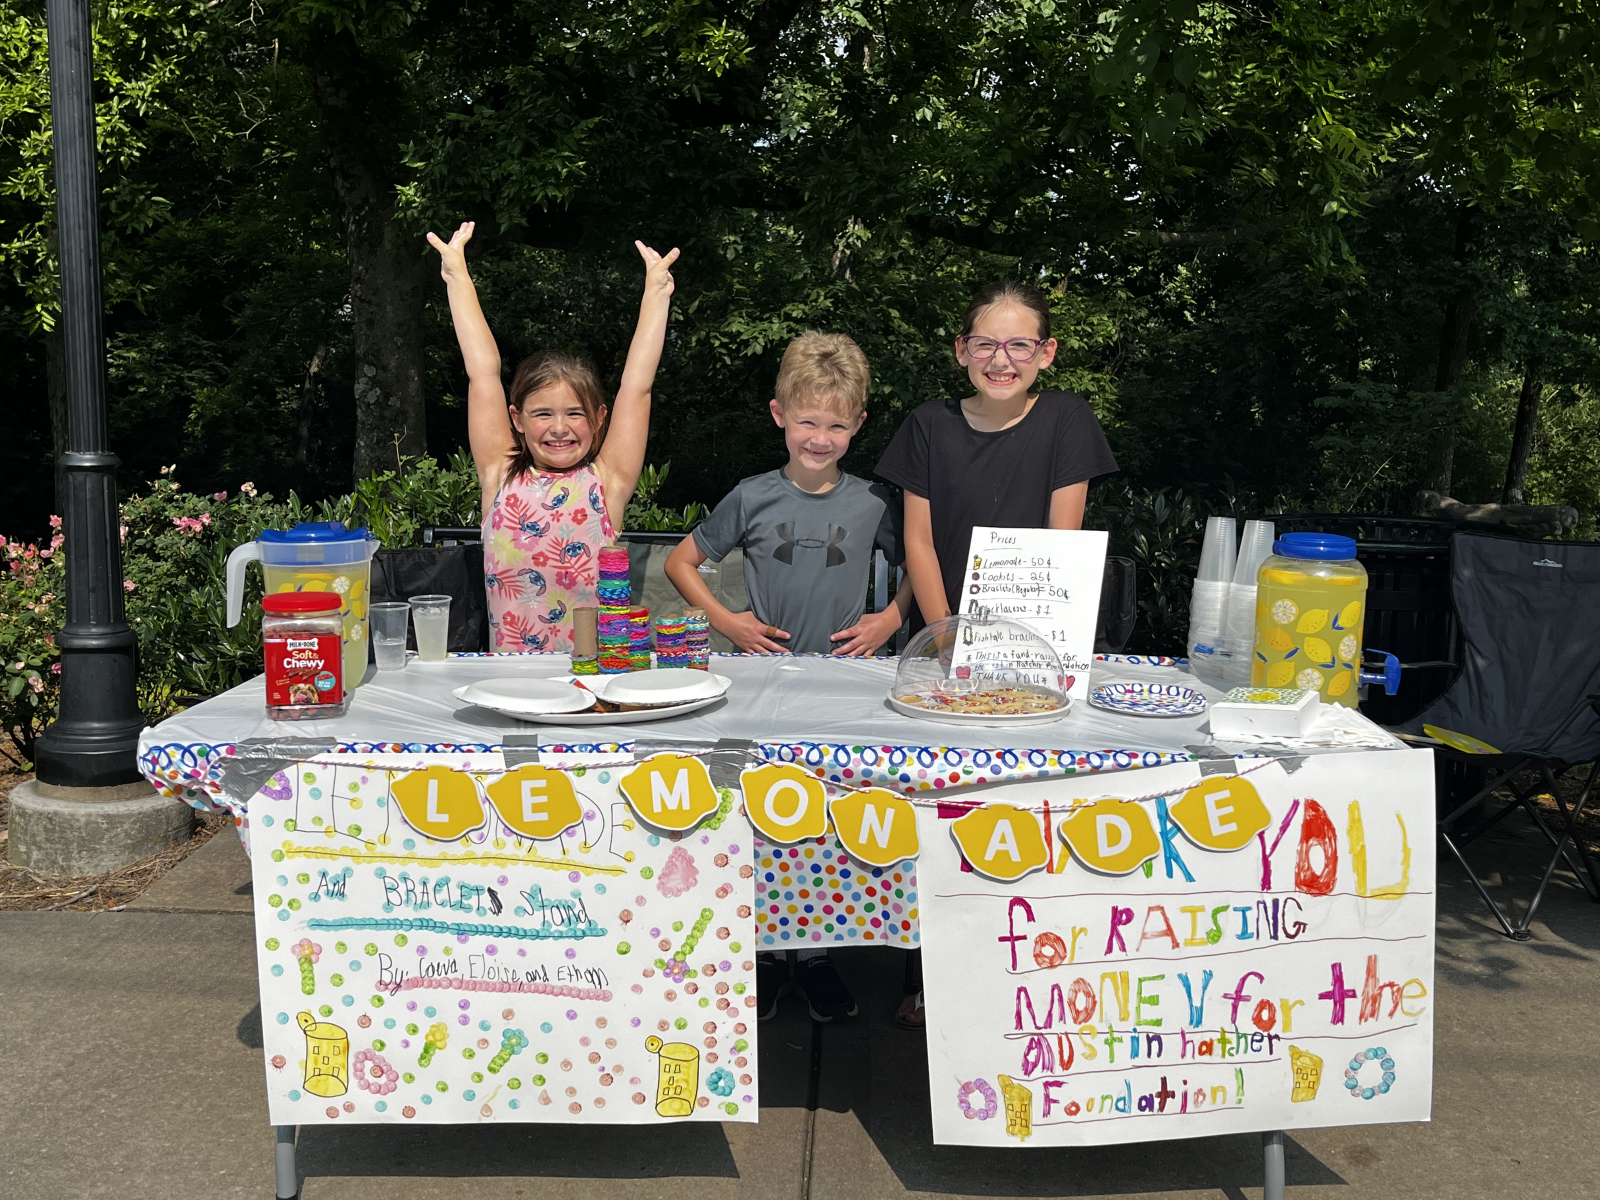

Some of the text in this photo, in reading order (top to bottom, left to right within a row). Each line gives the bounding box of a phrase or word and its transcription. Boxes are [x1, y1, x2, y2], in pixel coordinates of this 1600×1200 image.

[990, 532, 1017, 545] Prices
[283, 658, 325, 670] Chewy
[1062, 652, 1078, 662] for
[1258, 798, 1412, 901] YOU
[314, 872, 347, 900] And
[382, 875, 503, 916] BRACLET
[998, 897, 1308, 972] for RAISING
[378, 952, 410, 997] By:
[525, 964, 550, 983] and
[1221, 971, 1305, 1033] for
[1318, 954, 1428, 1026] the
[1180, 1024, 1281, 1060] hatcher
[1042, 1067, 1245, 1118] Foundation!
